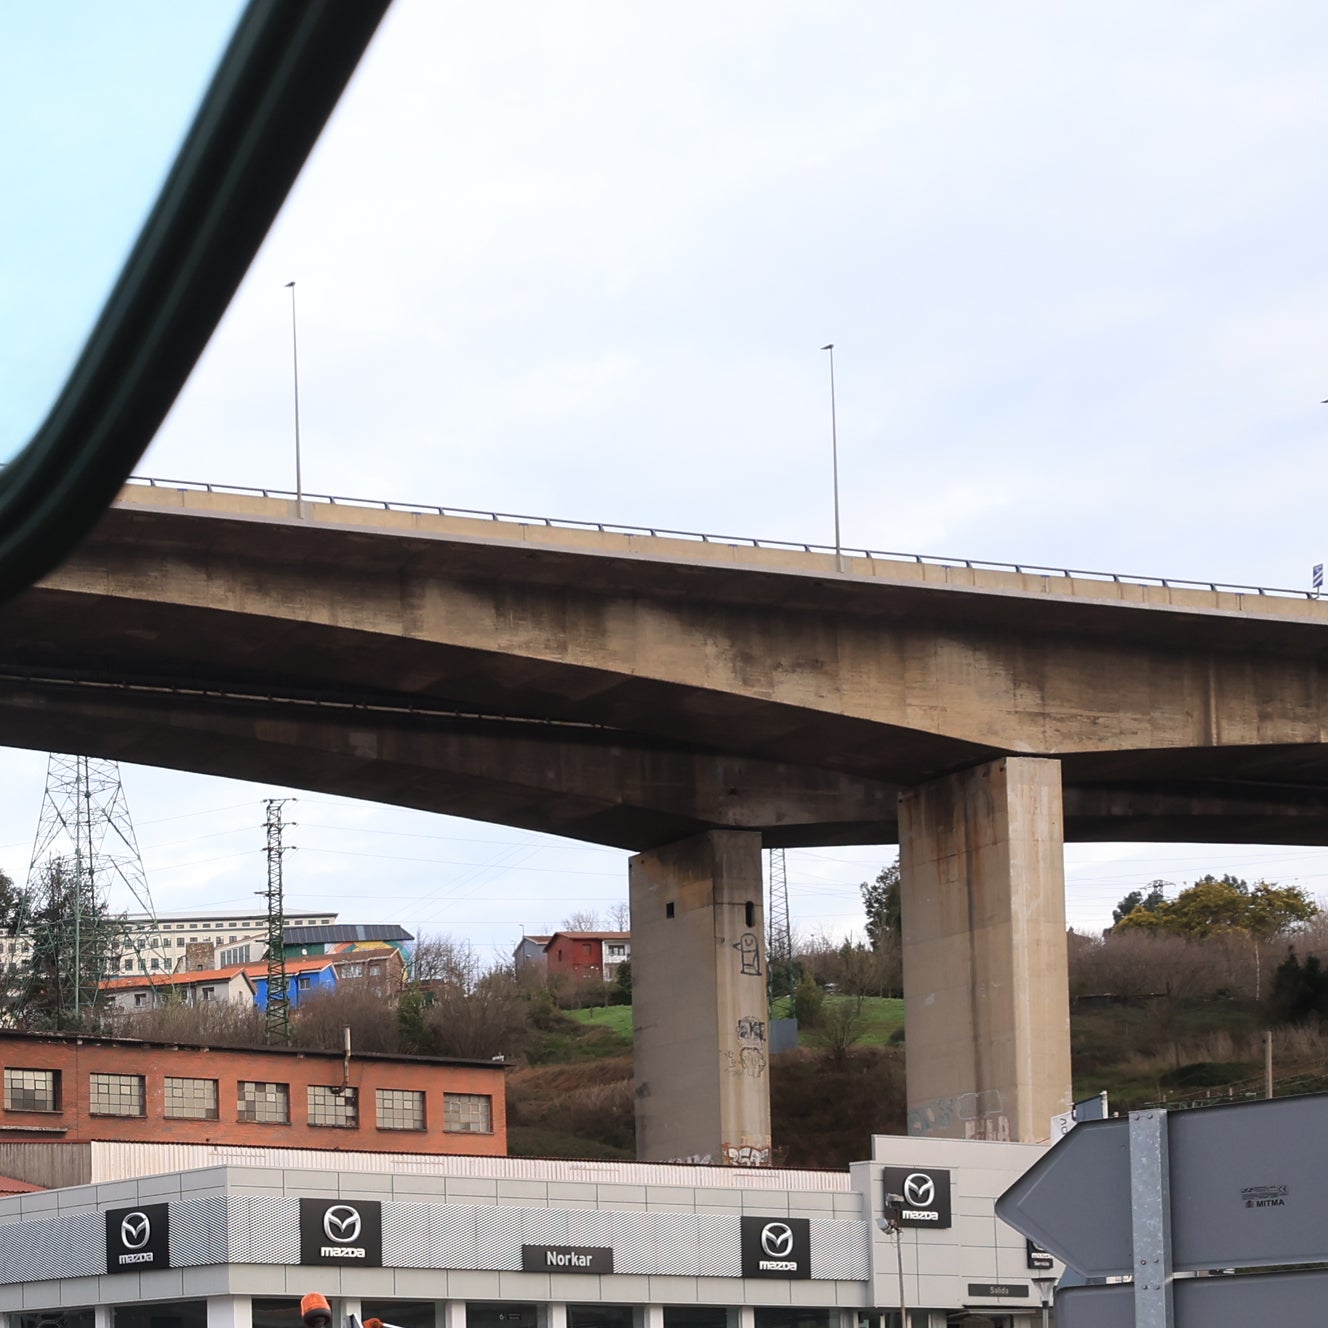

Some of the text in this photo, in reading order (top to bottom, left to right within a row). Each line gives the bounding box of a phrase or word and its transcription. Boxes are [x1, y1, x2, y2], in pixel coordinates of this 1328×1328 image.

[1256, 1199, 1285, 1207] MITMA
[902, 1210, 938, 1221] mazda
[321, 1247, 365, 1258] mazda
[119, 1252, 153, 1265] mazda
[546, 1251, 592, 1267] Norkar
[759, 1261, 797, 1271] mazda
